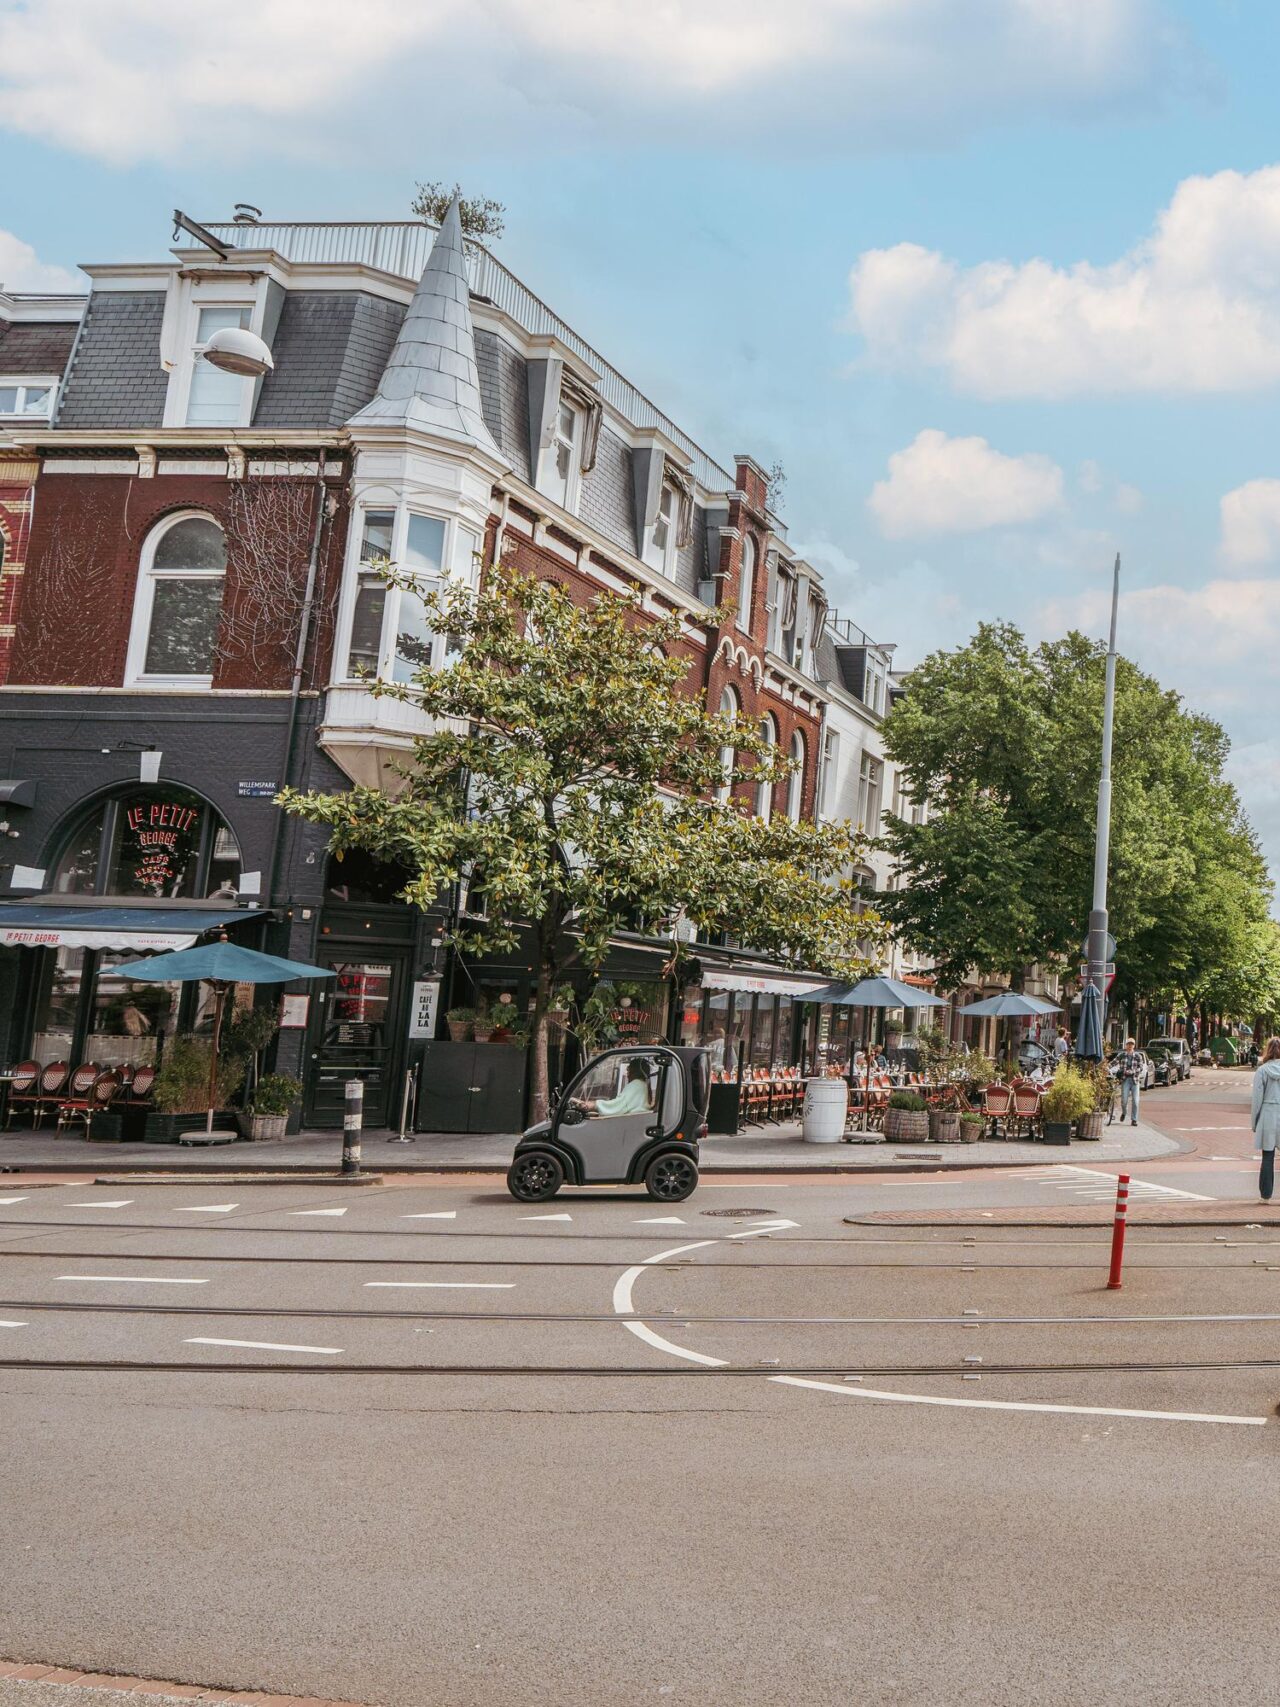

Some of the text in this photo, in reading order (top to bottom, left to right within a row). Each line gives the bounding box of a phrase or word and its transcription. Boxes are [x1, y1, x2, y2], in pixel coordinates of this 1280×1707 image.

[128, 804, 198, 832] LE PETIT
[140, 831, 178, 846] GEORGE
[13, 932, 34, 942] PETIT
[35, 933, 61, 943] GEORGE
[623, 1007, 651, 1024] PETIT
